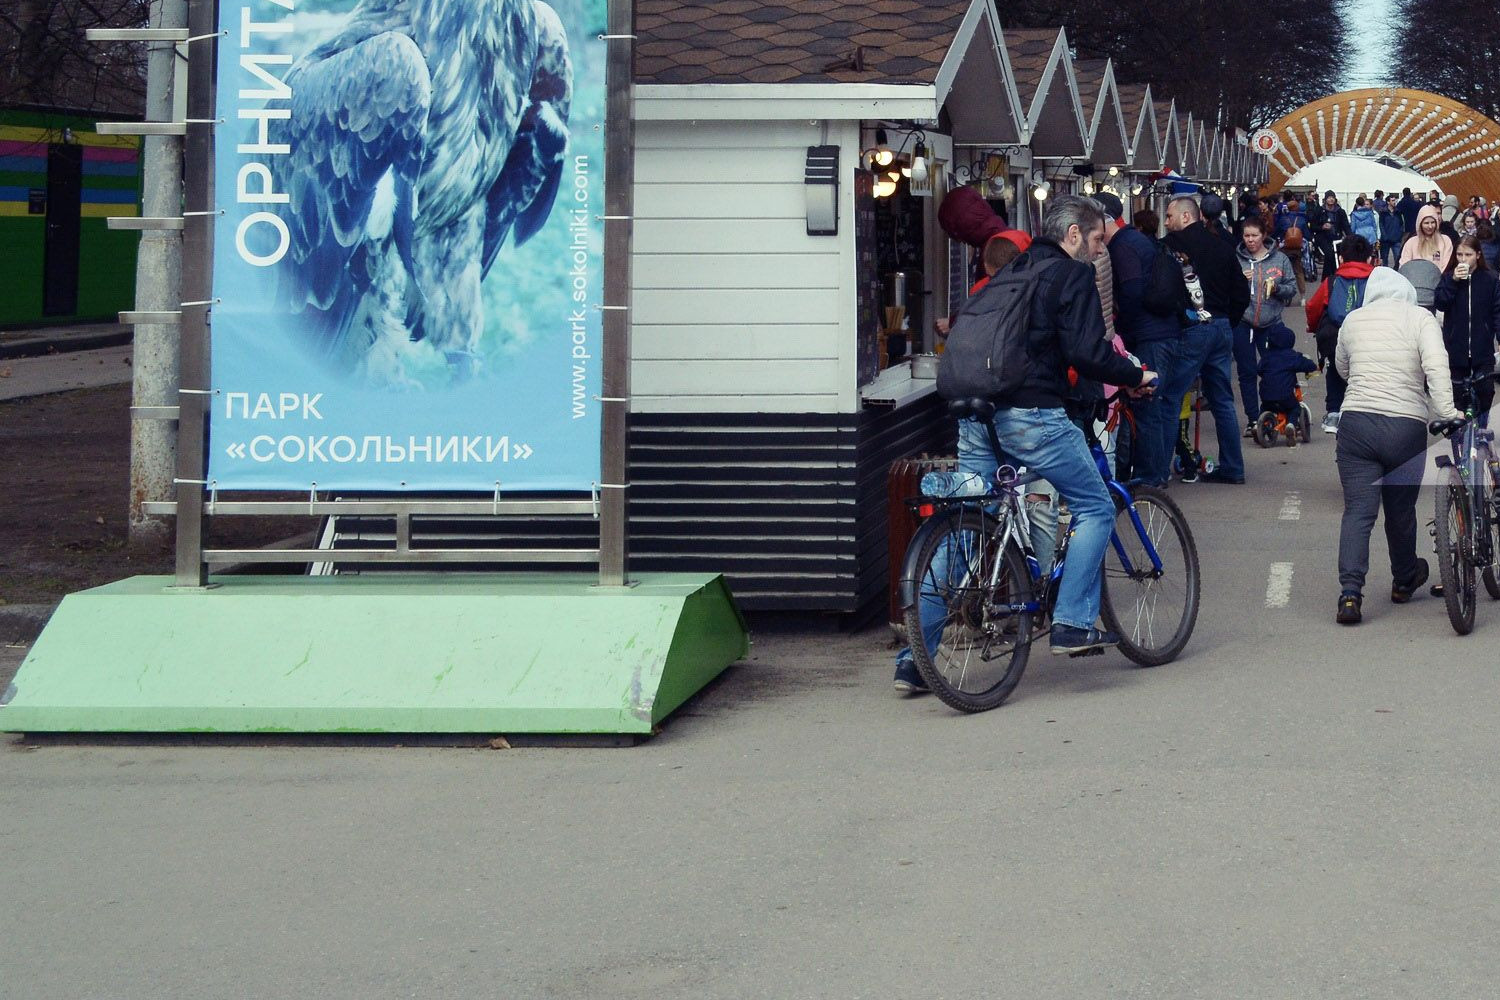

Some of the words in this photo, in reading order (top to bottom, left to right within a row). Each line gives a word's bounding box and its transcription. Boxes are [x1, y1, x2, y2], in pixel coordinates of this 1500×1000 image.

[567, 154, 590, 419] www.park.sokolniki.com
[226, 392, 323, 420] ПАРК
[225, 435, 534, 462] «СОКОЛЬНИКИ»
